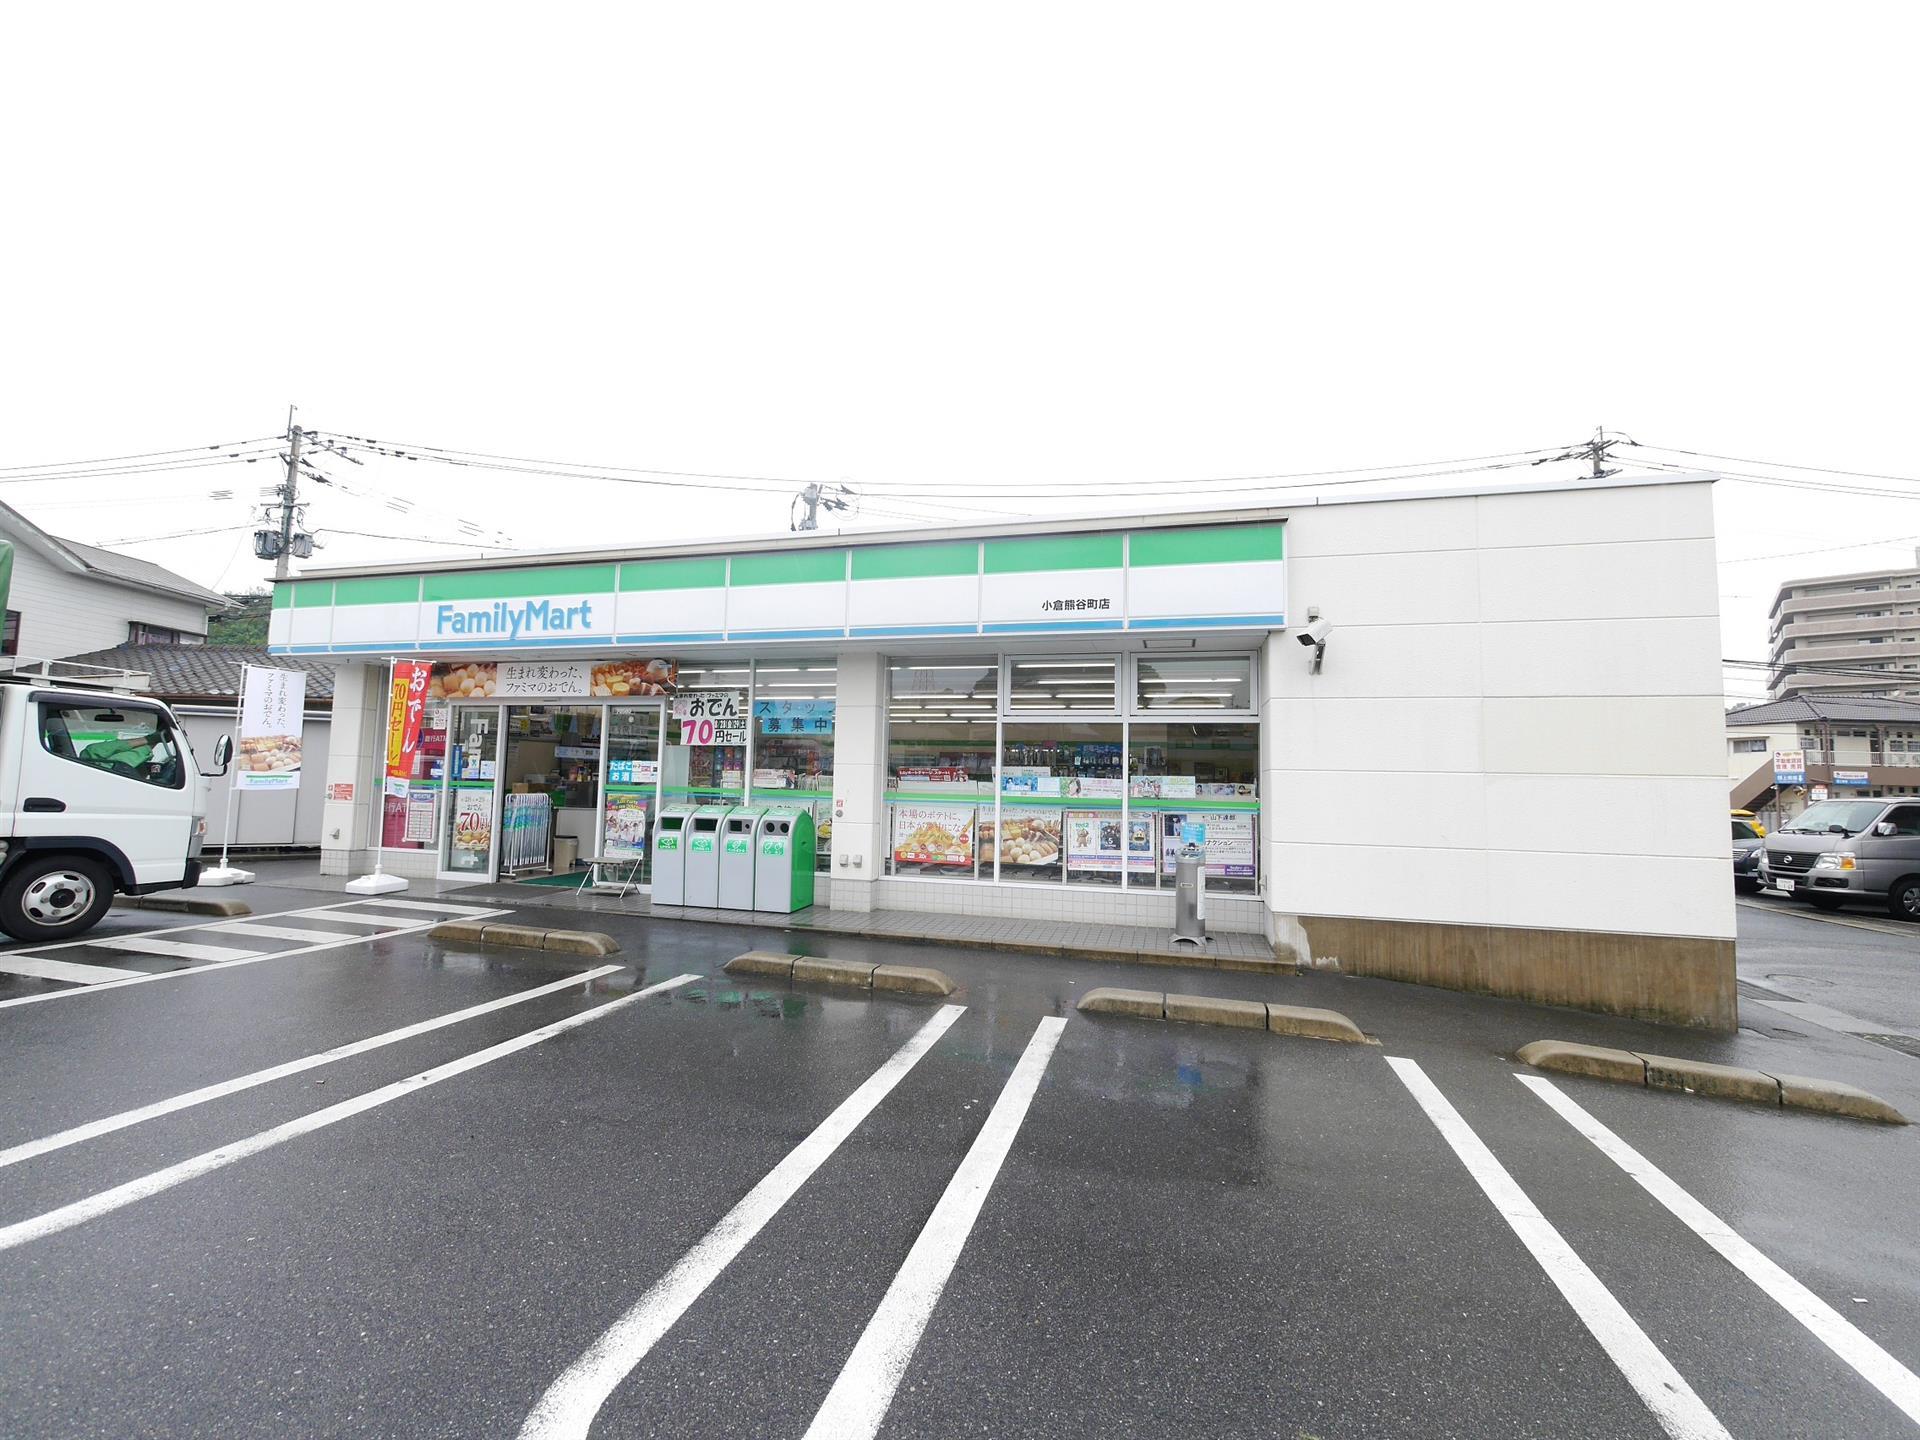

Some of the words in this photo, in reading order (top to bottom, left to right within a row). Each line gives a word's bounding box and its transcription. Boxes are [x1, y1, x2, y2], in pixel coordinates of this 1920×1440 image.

[1042, 598, 1110, 611] 小倉熊谷町店
[437, 600, 592, 640] FamilyMart
[506, 666, 583, 680] 生まれ変わった、
[506, 682, 583, 694] ファミマのおでん。
[403, 667, 427, 753] おでん
[690, 698, 737, 717] おでん
[682, 720, 713, 745] 70
[715, 730, 747, 742] 円セール
[768, 717, 828, 733] 募集中
[610, 760, 632, 771] たばこ
[460, 812, 480, 831] 70
